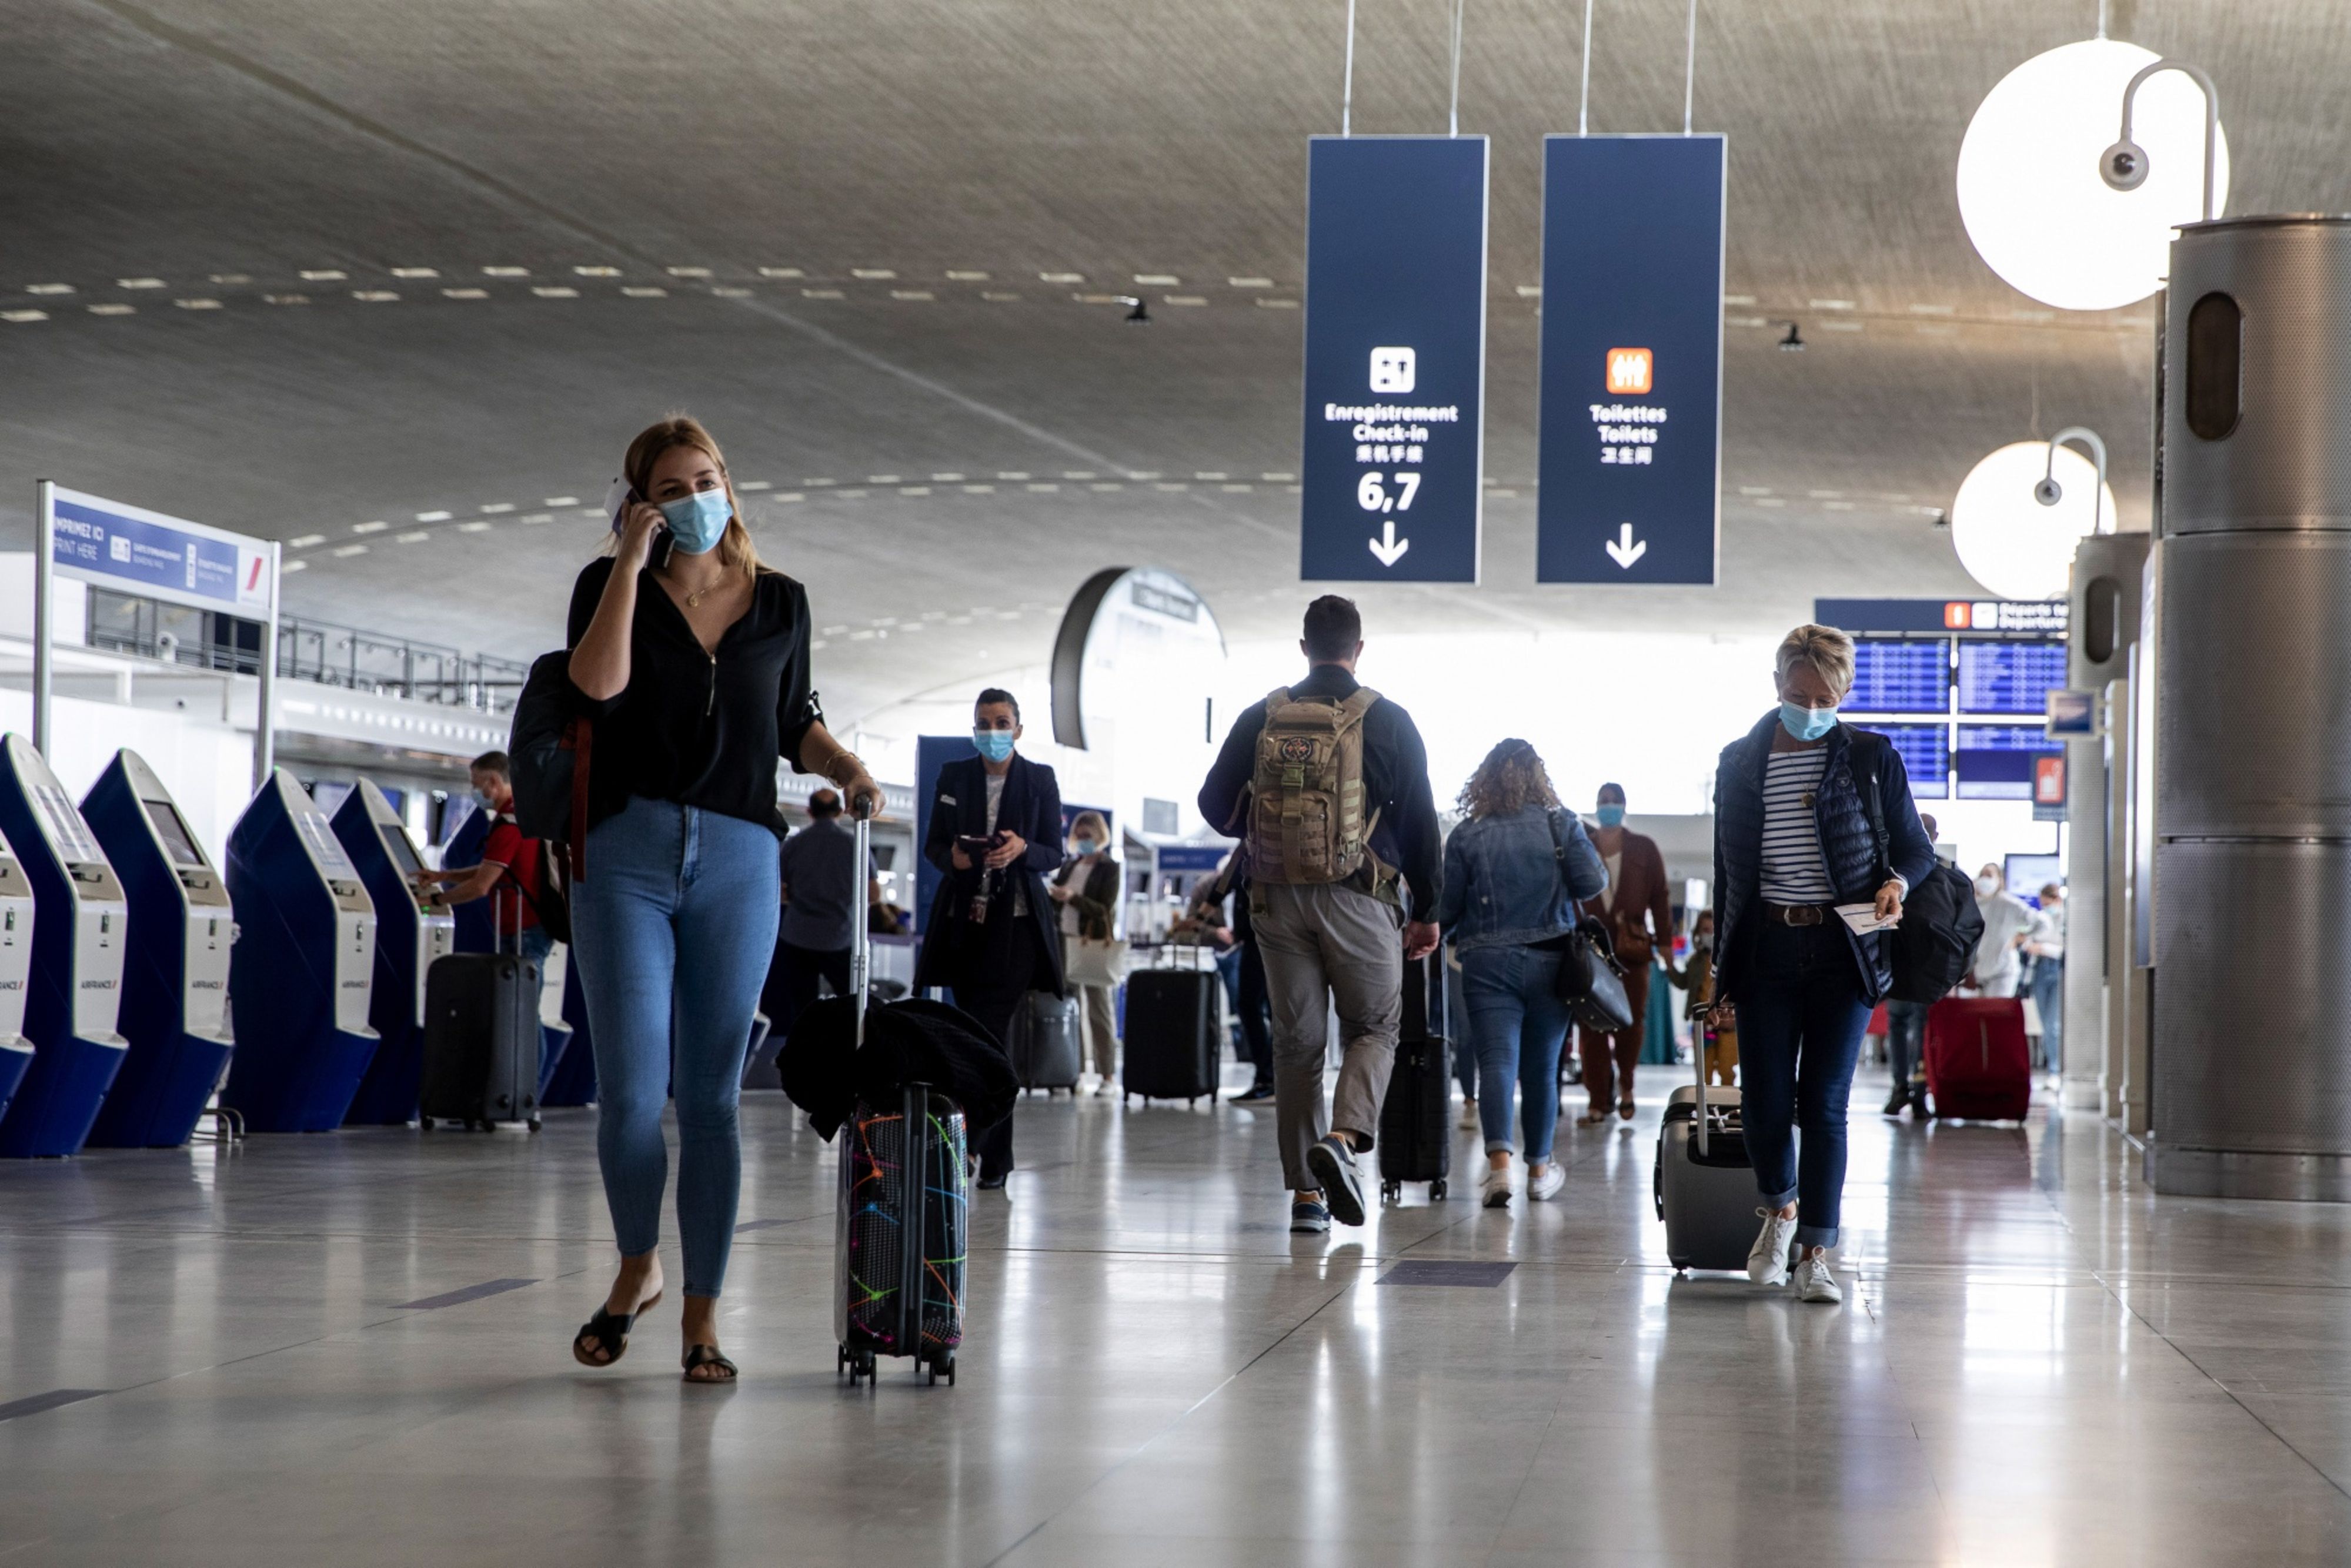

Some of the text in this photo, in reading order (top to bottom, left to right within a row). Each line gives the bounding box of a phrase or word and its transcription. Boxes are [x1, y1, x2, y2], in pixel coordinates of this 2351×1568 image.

[1325, 403, 1458, 424] Enregistrement
[1589, 404, 1668, 423] Toilettes
[1353, 423, 1429, 442] Check-in
[1597, 424, 1658, 443] Toilets
[1600, 446, 1652, 465] 卫生间
[1357, 471, 1421, 513] 6,7
